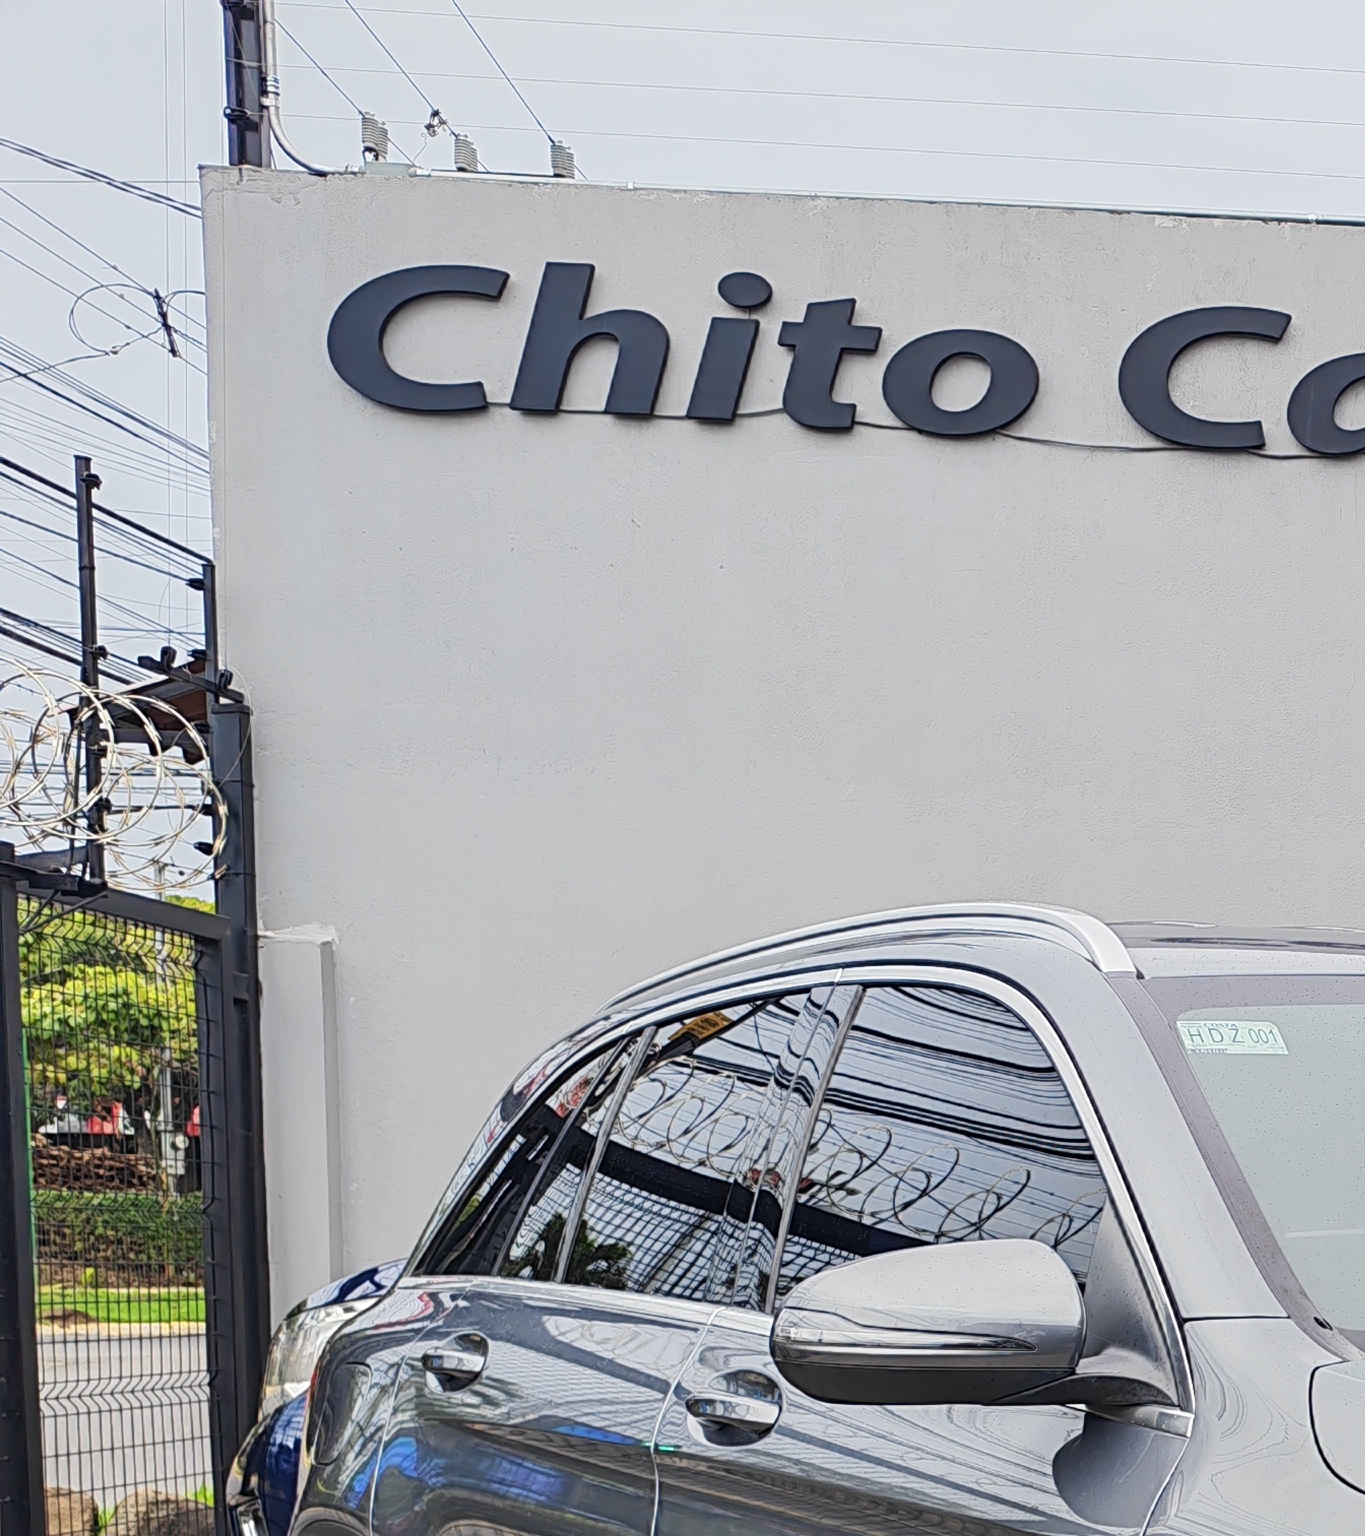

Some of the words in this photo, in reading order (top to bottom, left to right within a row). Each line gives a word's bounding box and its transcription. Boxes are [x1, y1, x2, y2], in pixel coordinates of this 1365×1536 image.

[327, 262, 1039, 439] Chito
[1187, 1027, 1245, 1043] HDZ
[1248, 1028, 1278, 1044] 001
